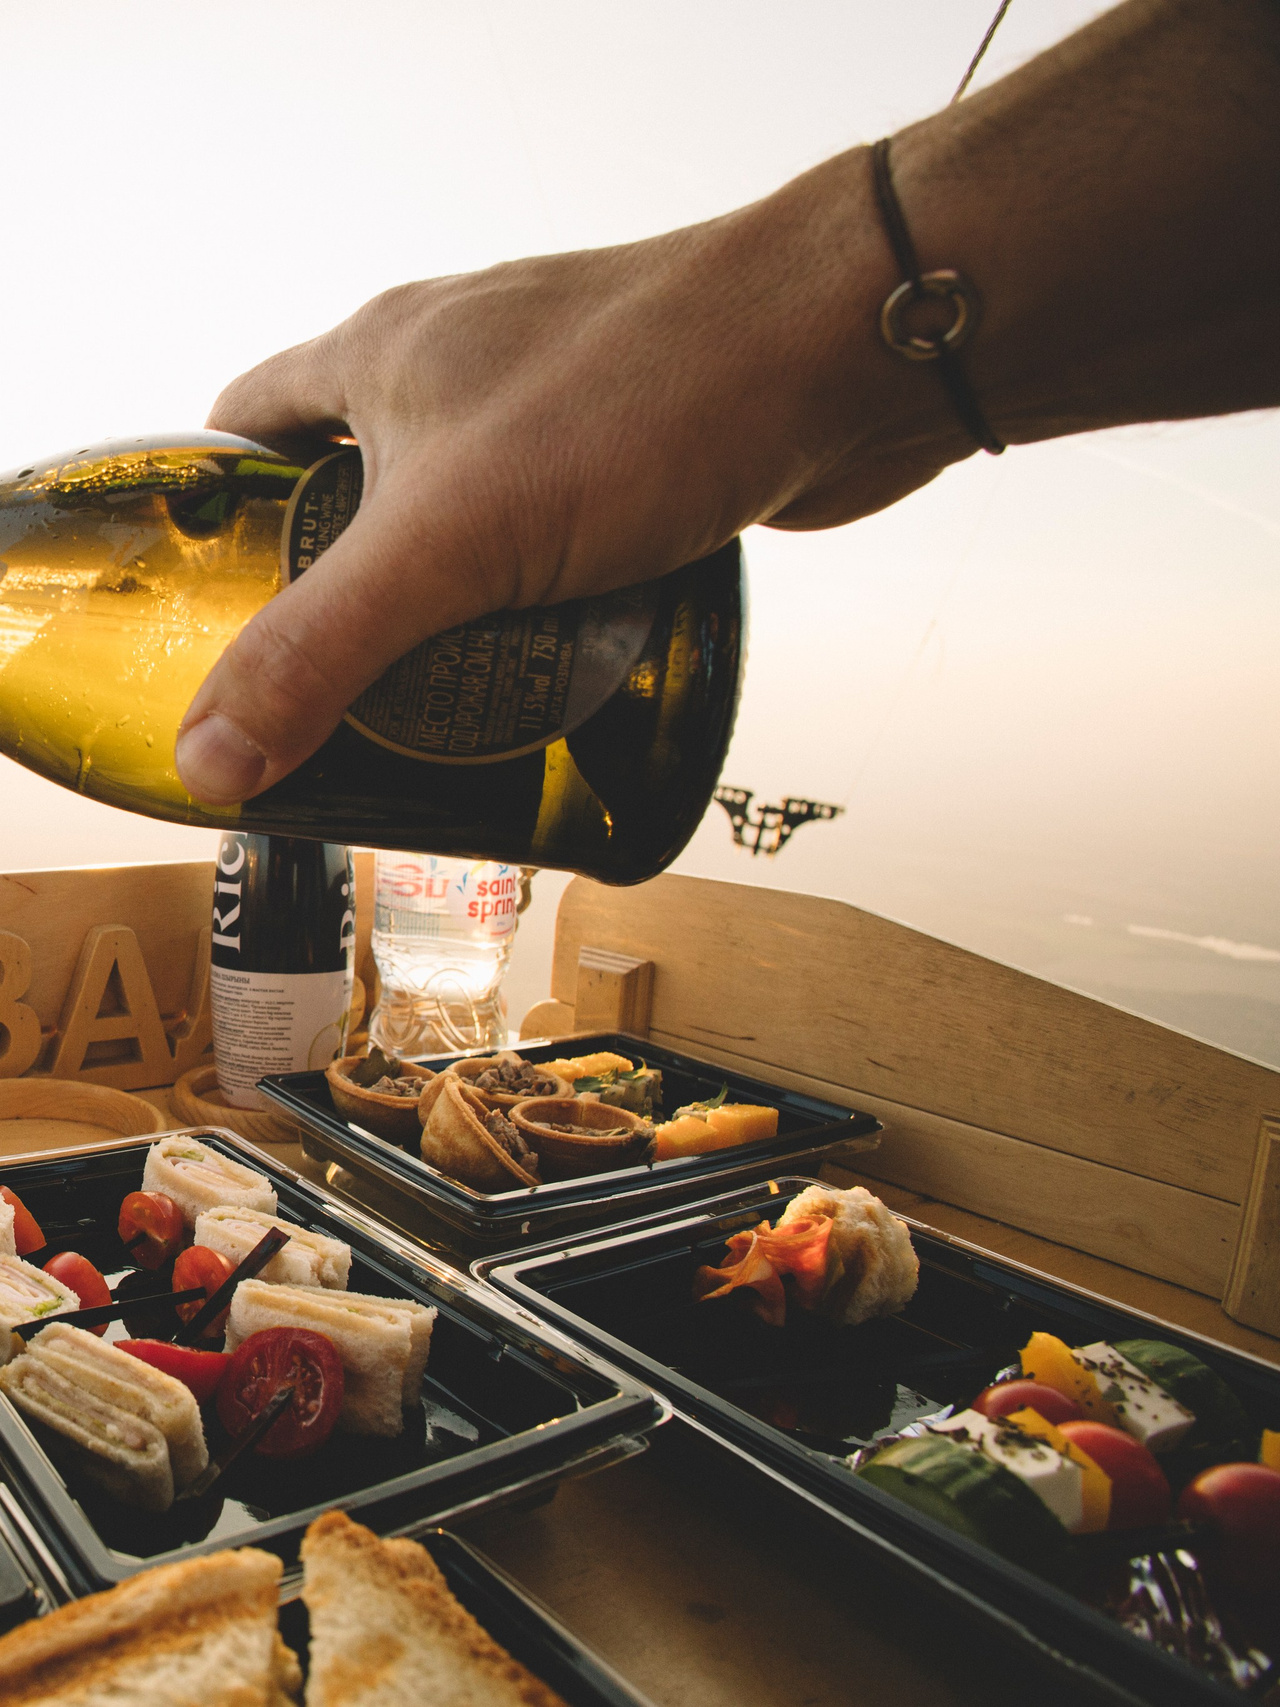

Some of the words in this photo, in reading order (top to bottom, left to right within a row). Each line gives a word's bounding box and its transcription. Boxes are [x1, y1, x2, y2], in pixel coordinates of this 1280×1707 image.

[322, 493, 335, 518] WINE
[531, 633, 558, 660] 750
[419, 689, 454, 749] МЕСТО
[548, 694, 563, 723] ДАТА
[448, 729, 483, 754] ГОД
[212, 833, 248, 954] Ric
